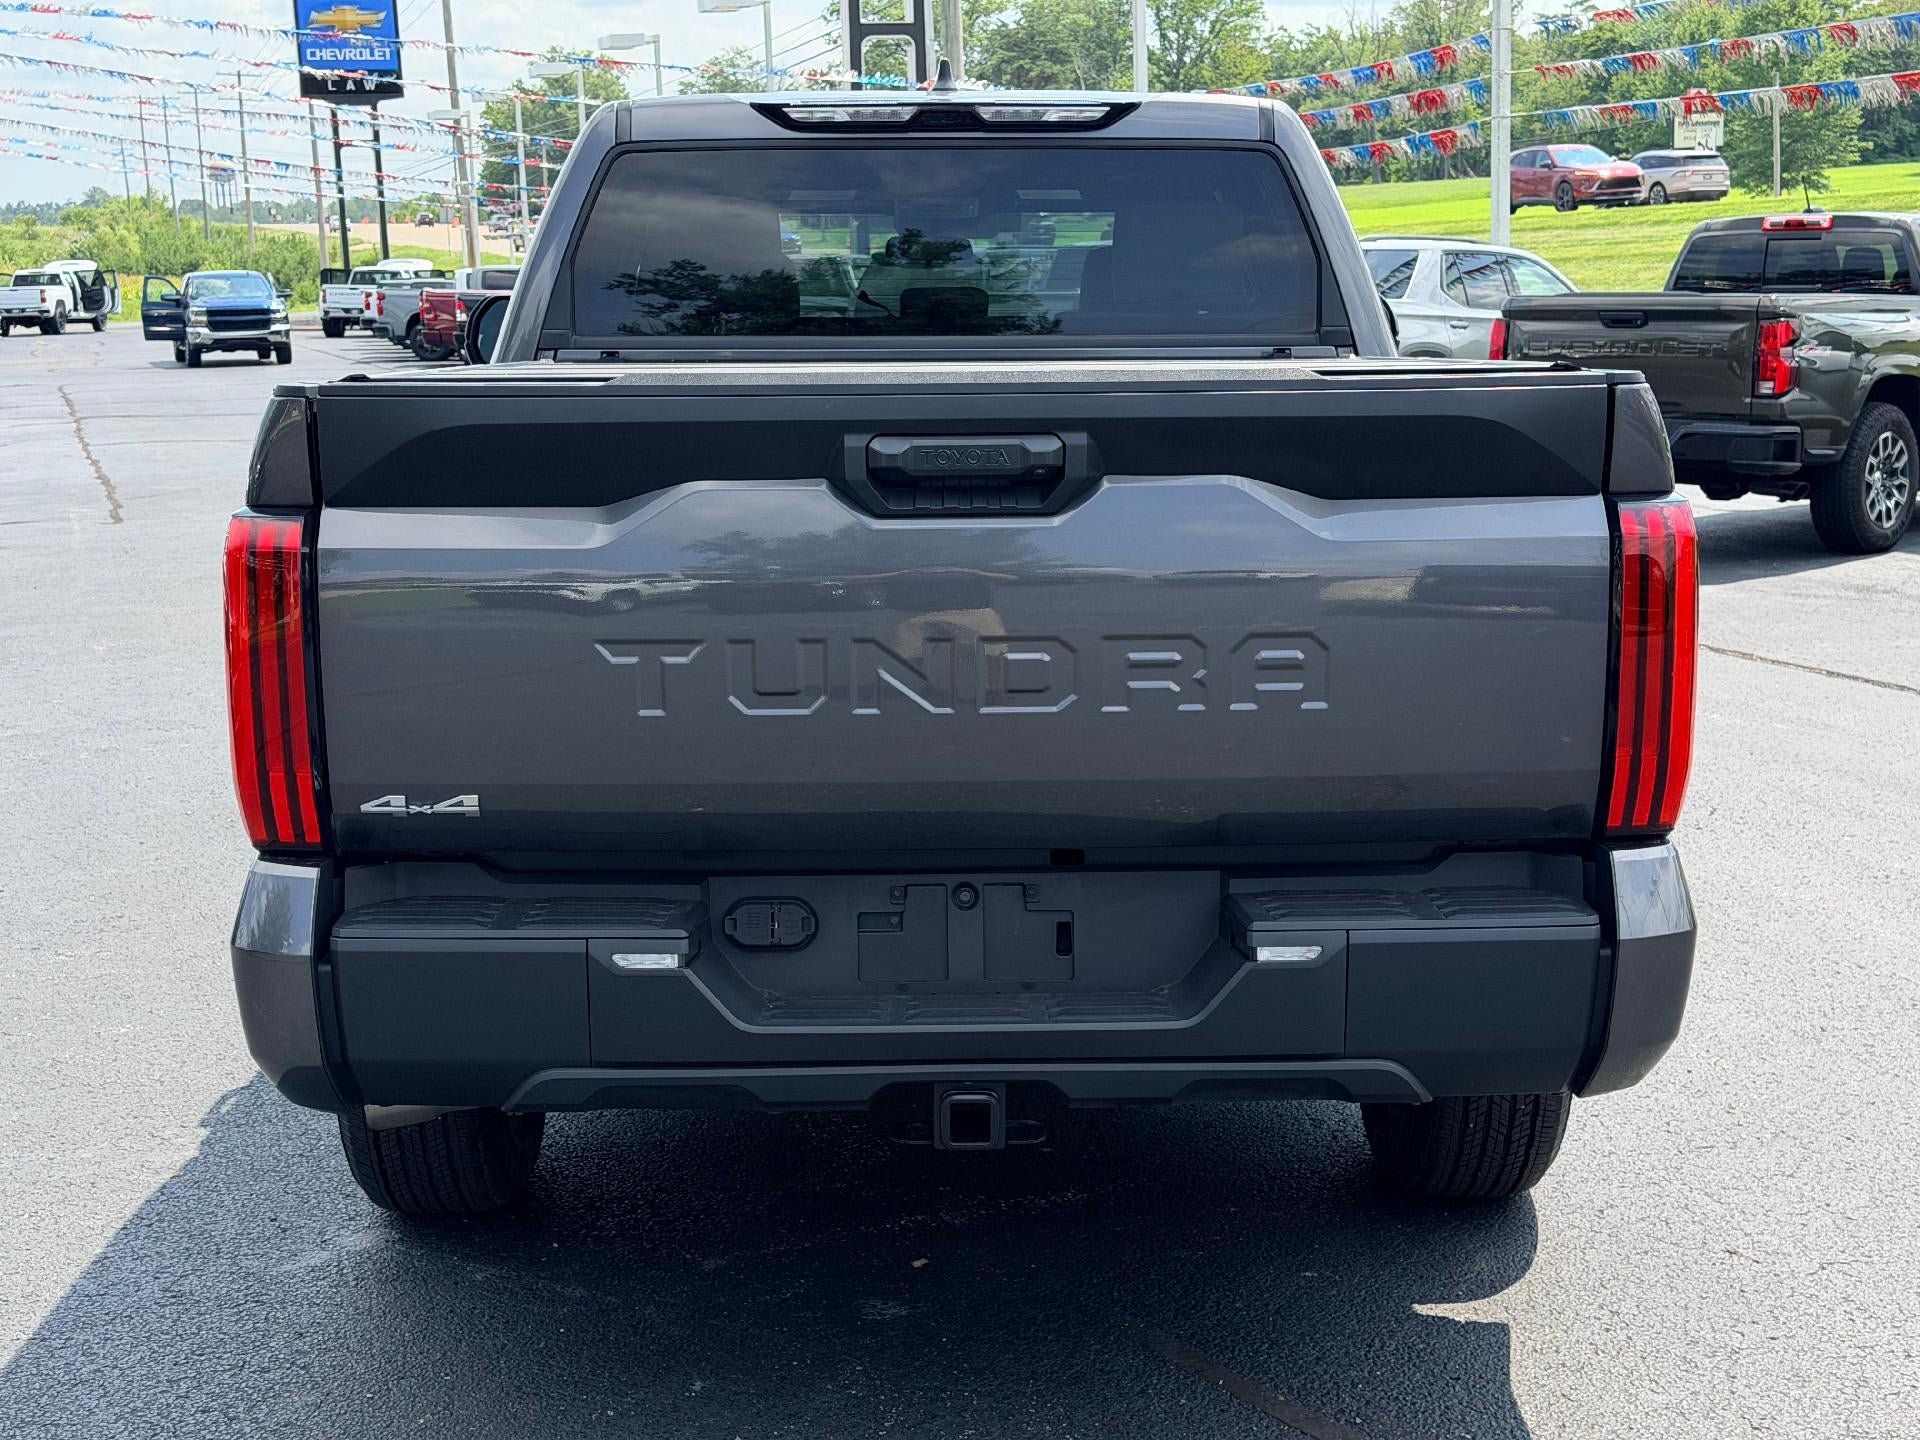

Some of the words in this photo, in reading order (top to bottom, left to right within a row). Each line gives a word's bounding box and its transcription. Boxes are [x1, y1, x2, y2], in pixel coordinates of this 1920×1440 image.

[306, 47, 391, 61] CHEVROLET
[326, 79, 376, 91] LAW
[919, 448, 1011, 466] TOYOTA
[593, 631, 1330, 716] TUNDRA
[360, 794, 481, 817] 4x4
